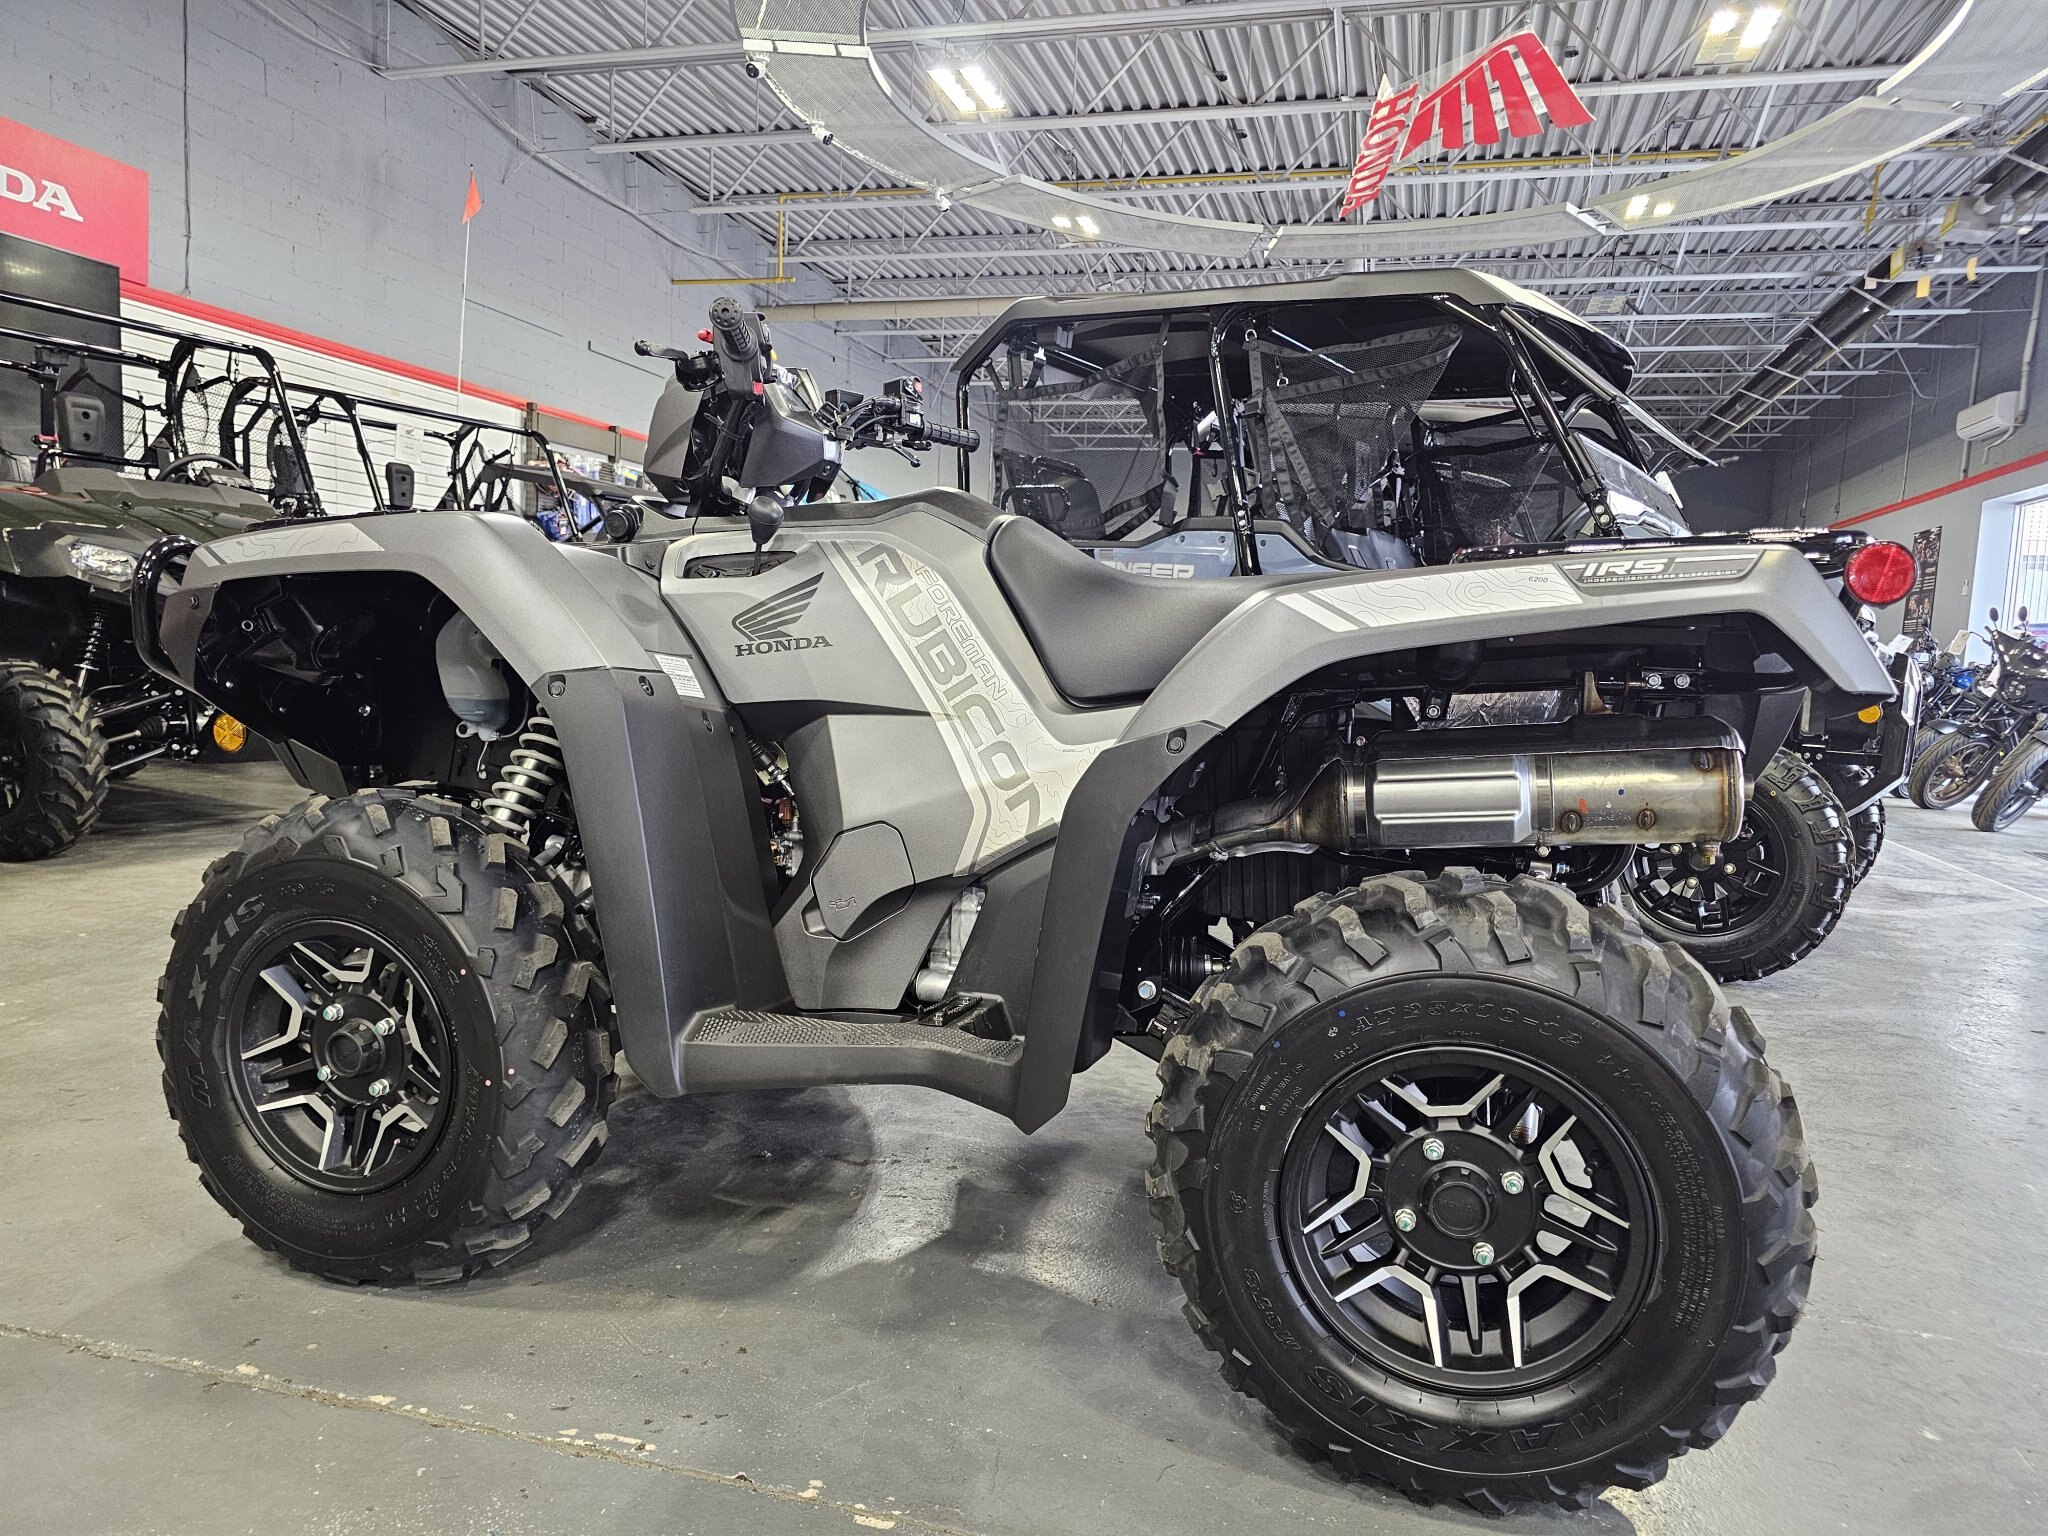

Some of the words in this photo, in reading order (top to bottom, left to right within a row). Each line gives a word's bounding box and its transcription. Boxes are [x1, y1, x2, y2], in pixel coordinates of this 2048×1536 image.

[1338, 81, 1419, 219] HONDA
[0, 164, 84, 223] DA
[1100, 560, 1195, 579] NEER
[1528, 575, 1549, 583] 6200
[1583, 557, 1669, 577] IRS
[734, 635, 834, 657] HONDA
[914, 565, 1007, 701] FOREMAN
[857, 542, 1060, 842] RUBICON
[184, 893, 266, 1109] MAXXIS
[1306, 1364, 1623, 1457] MAXXIS
